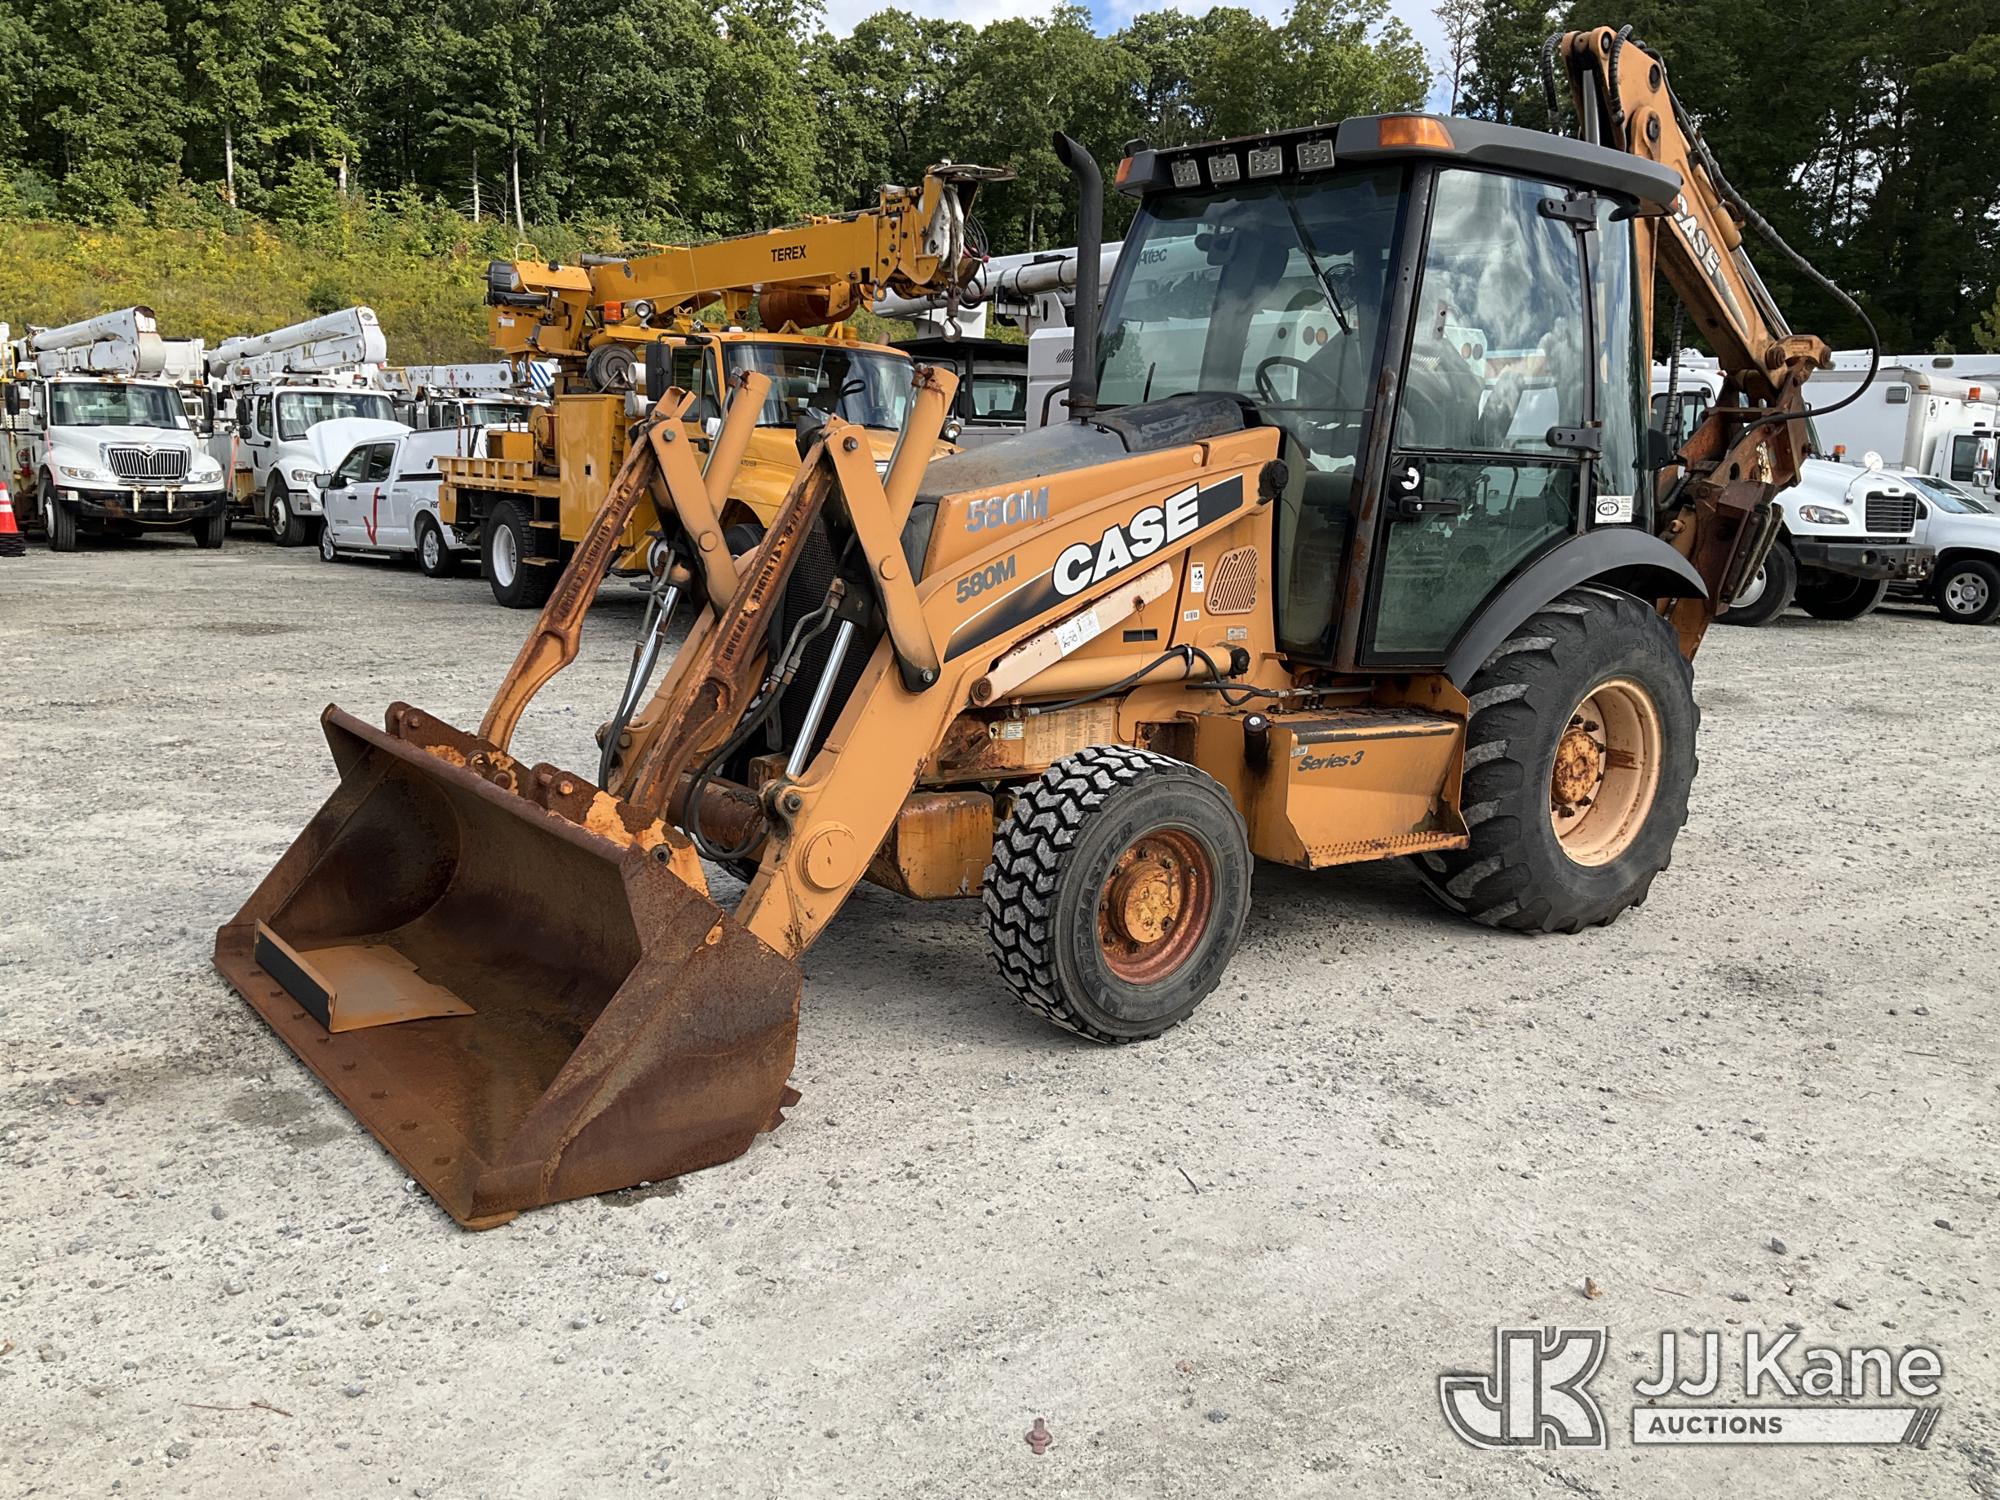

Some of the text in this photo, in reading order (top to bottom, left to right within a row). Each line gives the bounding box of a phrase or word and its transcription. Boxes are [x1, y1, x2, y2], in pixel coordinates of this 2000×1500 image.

[770, 244, 807, 263] TEREX
[1673, 193, 1721, 277] CASE
[964, 486, 1049, 533] 580M
[1052, 482, 1200, 596] CASE
[956, 554, 1016, 604] 580M
[1297, 750, 1365, 772] Series 3
